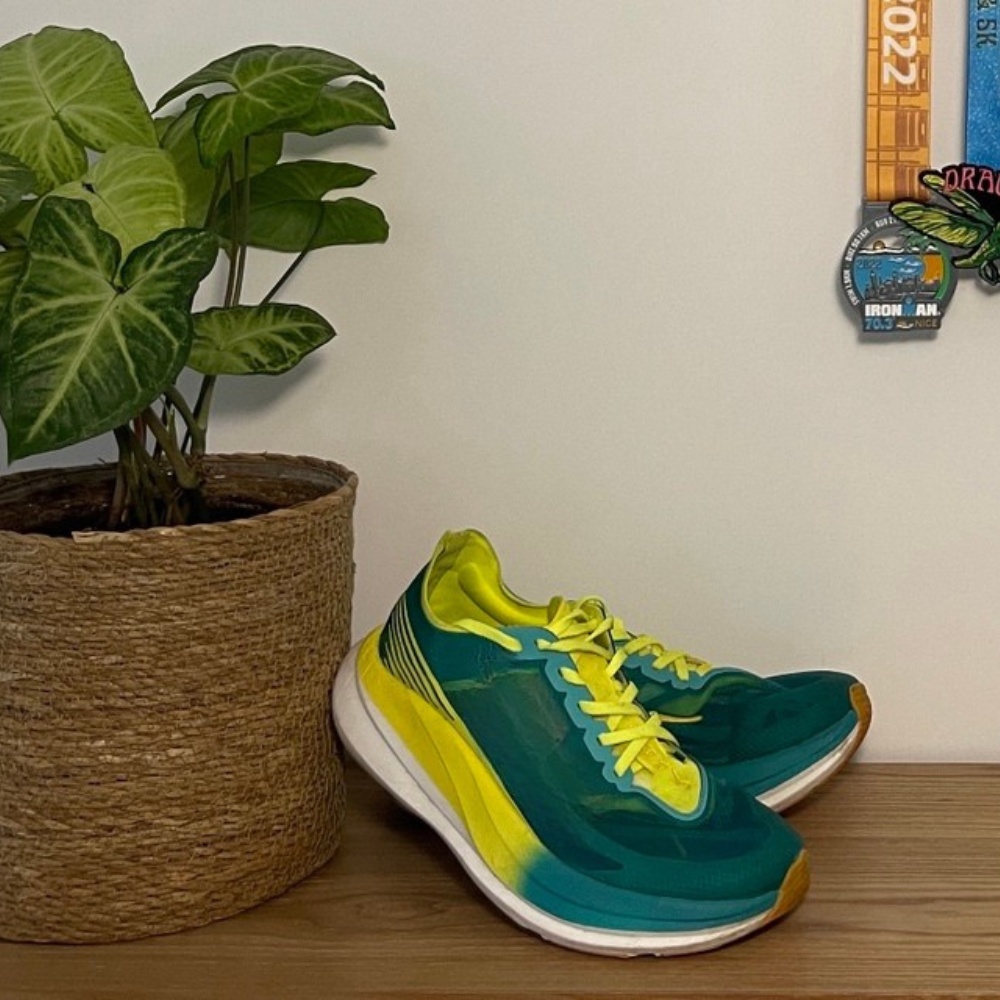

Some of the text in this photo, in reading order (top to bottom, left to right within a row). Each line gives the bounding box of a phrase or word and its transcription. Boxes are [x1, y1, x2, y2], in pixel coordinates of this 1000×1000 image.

[976, 18, 997, 48] 5K
[864, 297, 938, 317] IRONMAN
[864, 318, 938, 331] 70.3 NICE
